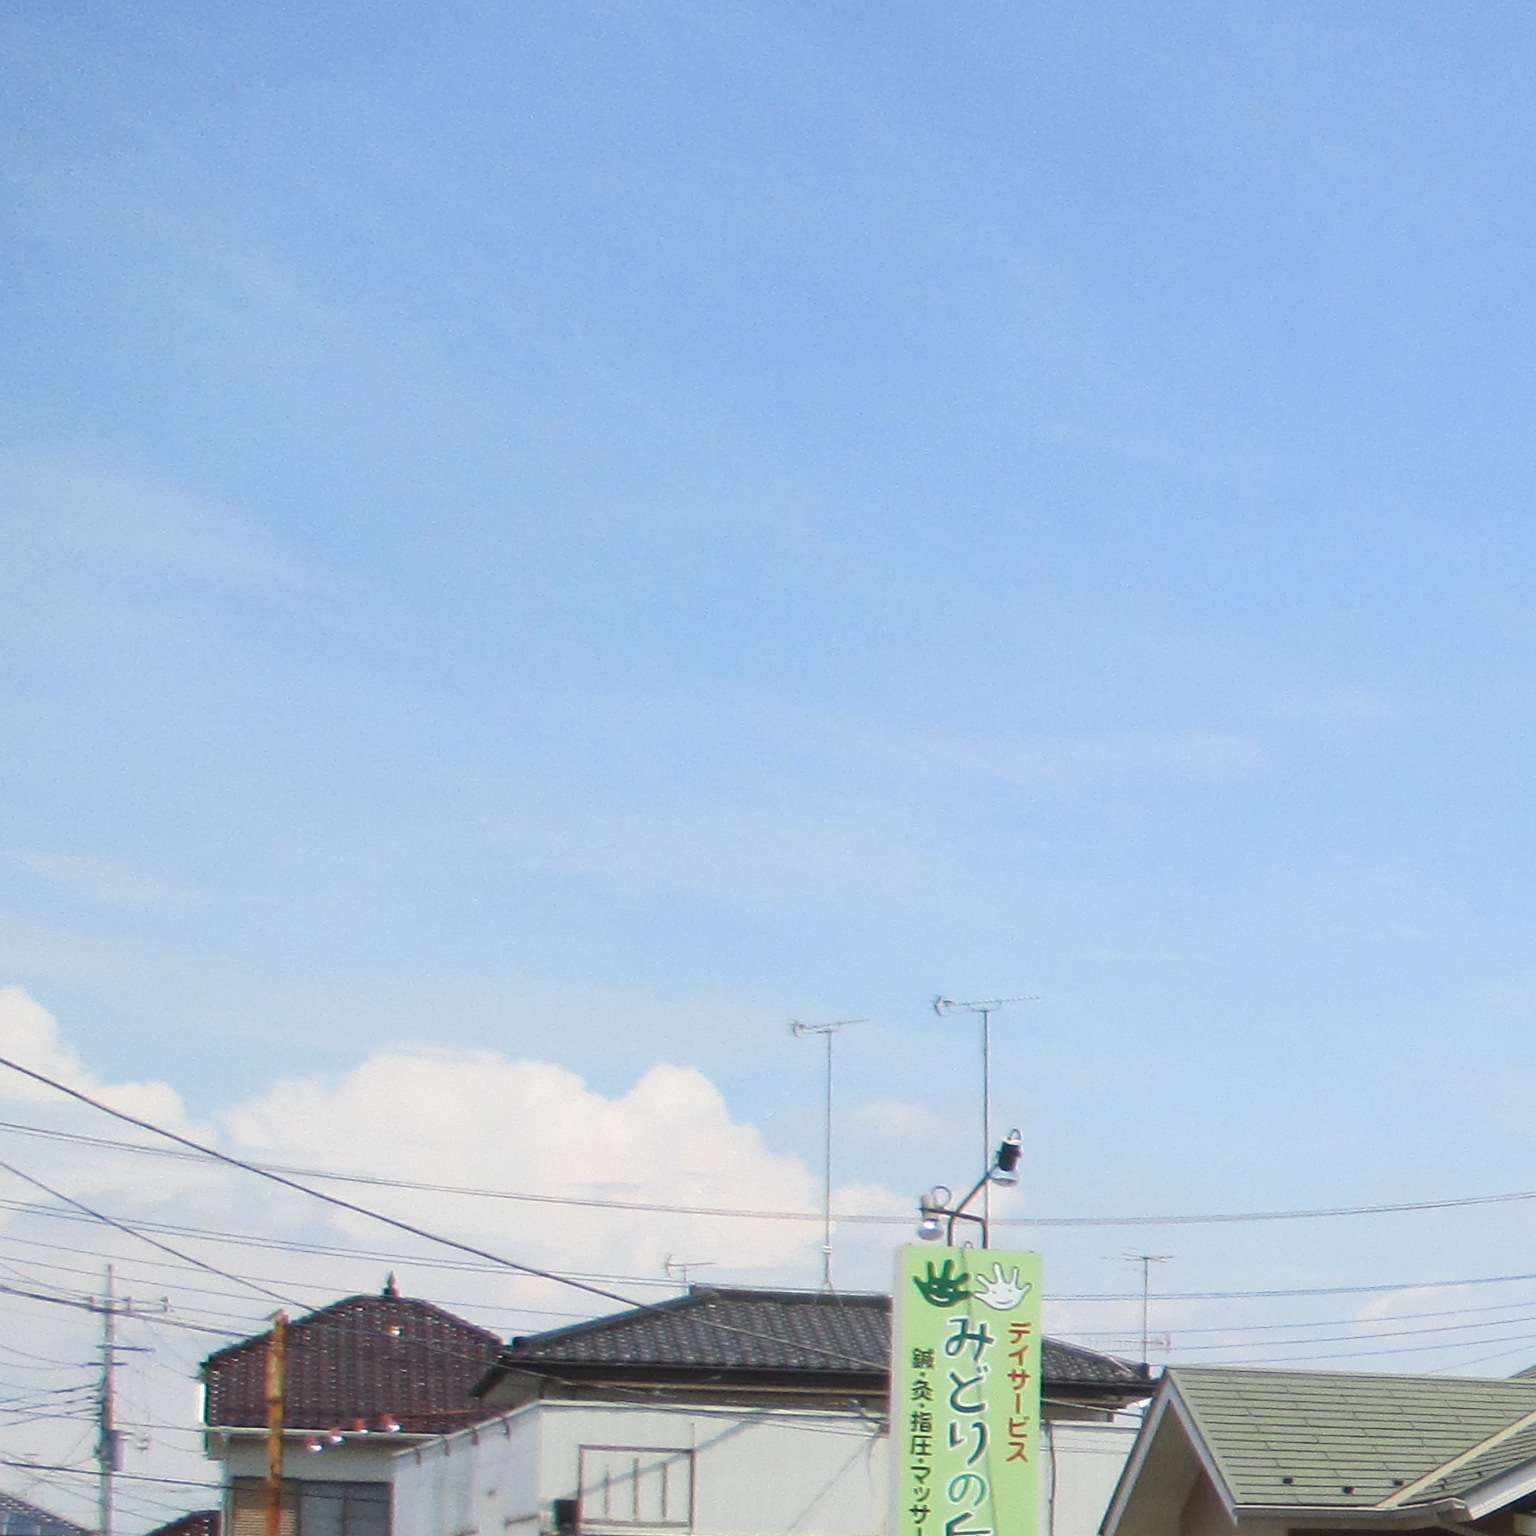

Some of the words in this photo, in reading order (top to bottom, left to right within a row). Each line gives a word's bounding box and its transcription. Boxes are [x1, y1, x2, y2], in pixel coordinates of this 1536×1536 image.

[1006, 1321, 1031, 1463] デイサービス
